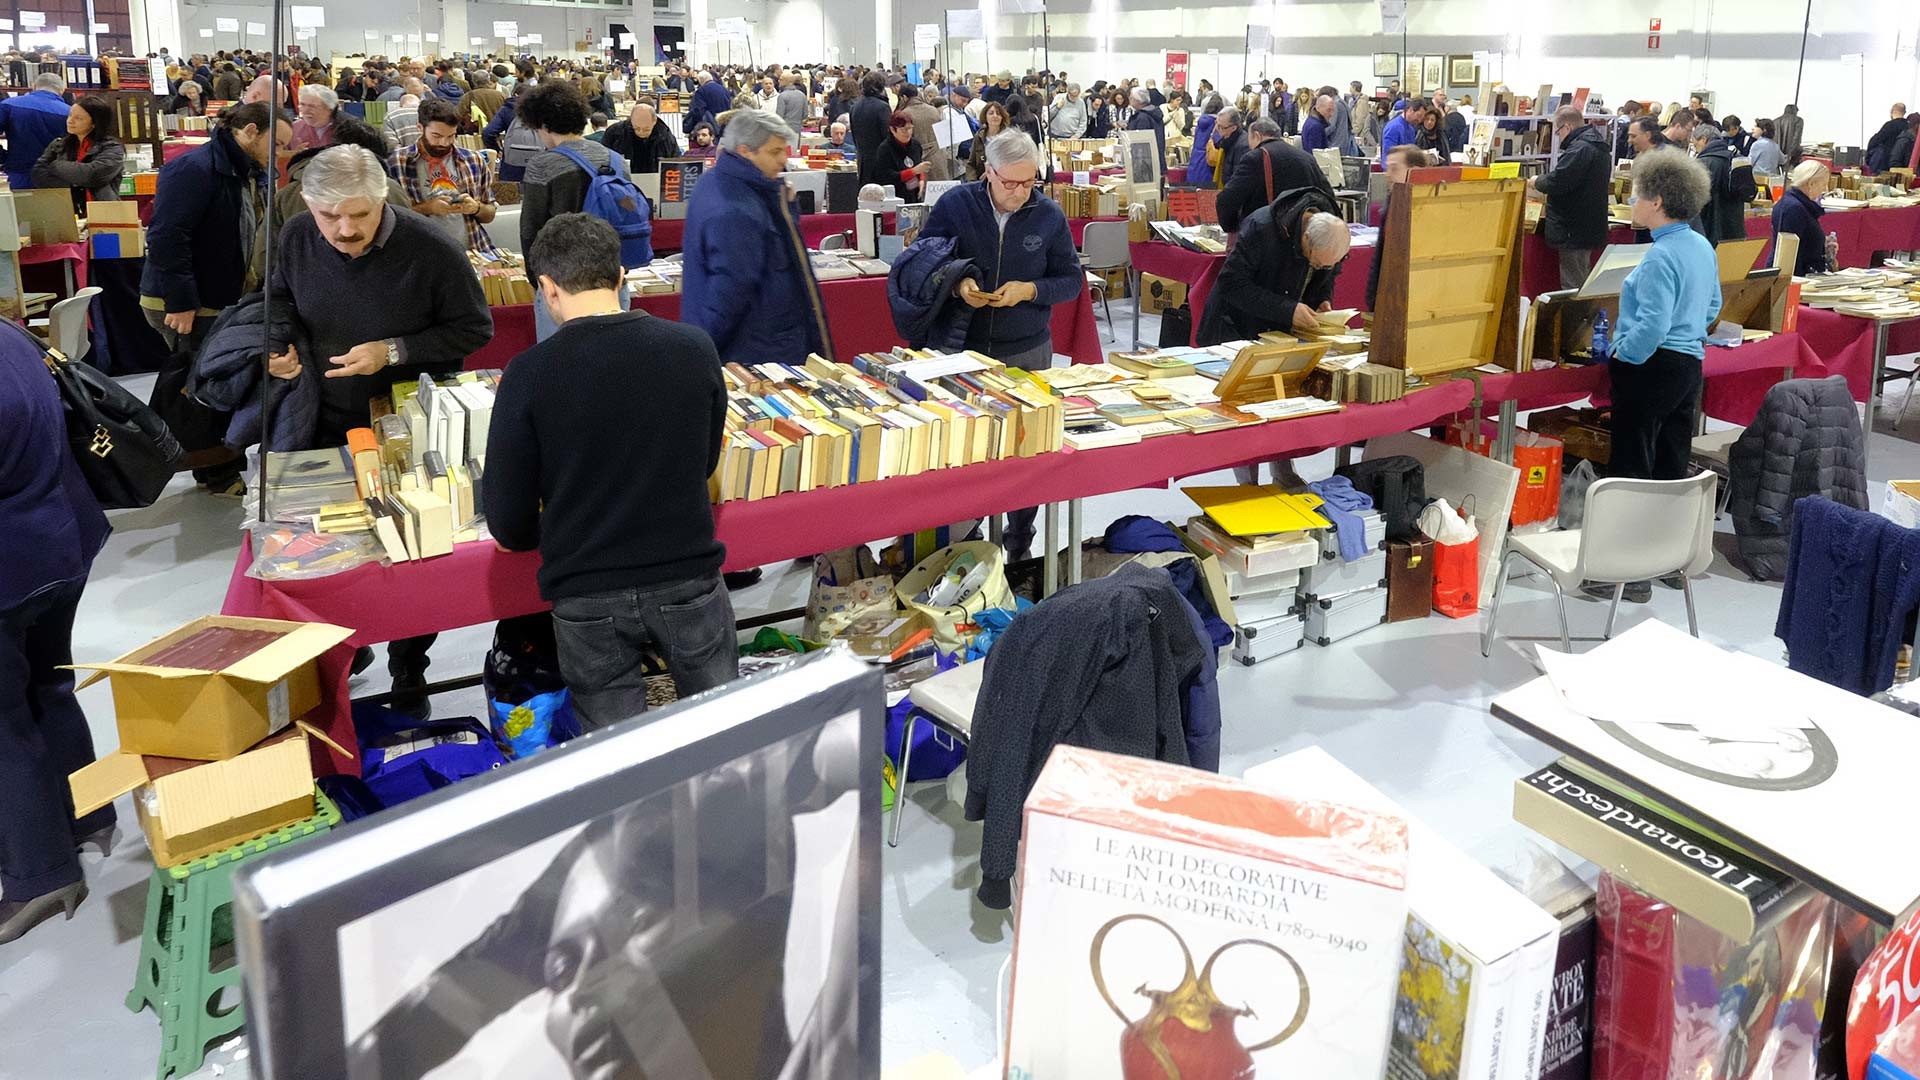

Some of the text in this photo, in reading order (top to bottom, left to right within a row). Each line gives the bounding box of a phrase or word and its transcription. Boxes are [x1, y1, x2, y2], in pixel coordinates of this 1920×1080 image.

[683, 165, 698, 200] TTERS
[1531, 770, 1763, 893] I leonardeschi
[1096, 837, 1329, 901] LE ARTI DECORATIVE
[1126, 864, 1290, 913] IN LOMBARDIA
[1153, 888, 1270, 930] MODERNA
[1548, 974, 1584, 1020] ATE
[1541, 1026, 1583, 1066] RHALEN
[1545, 1016, 1578, 1049] NDERE
